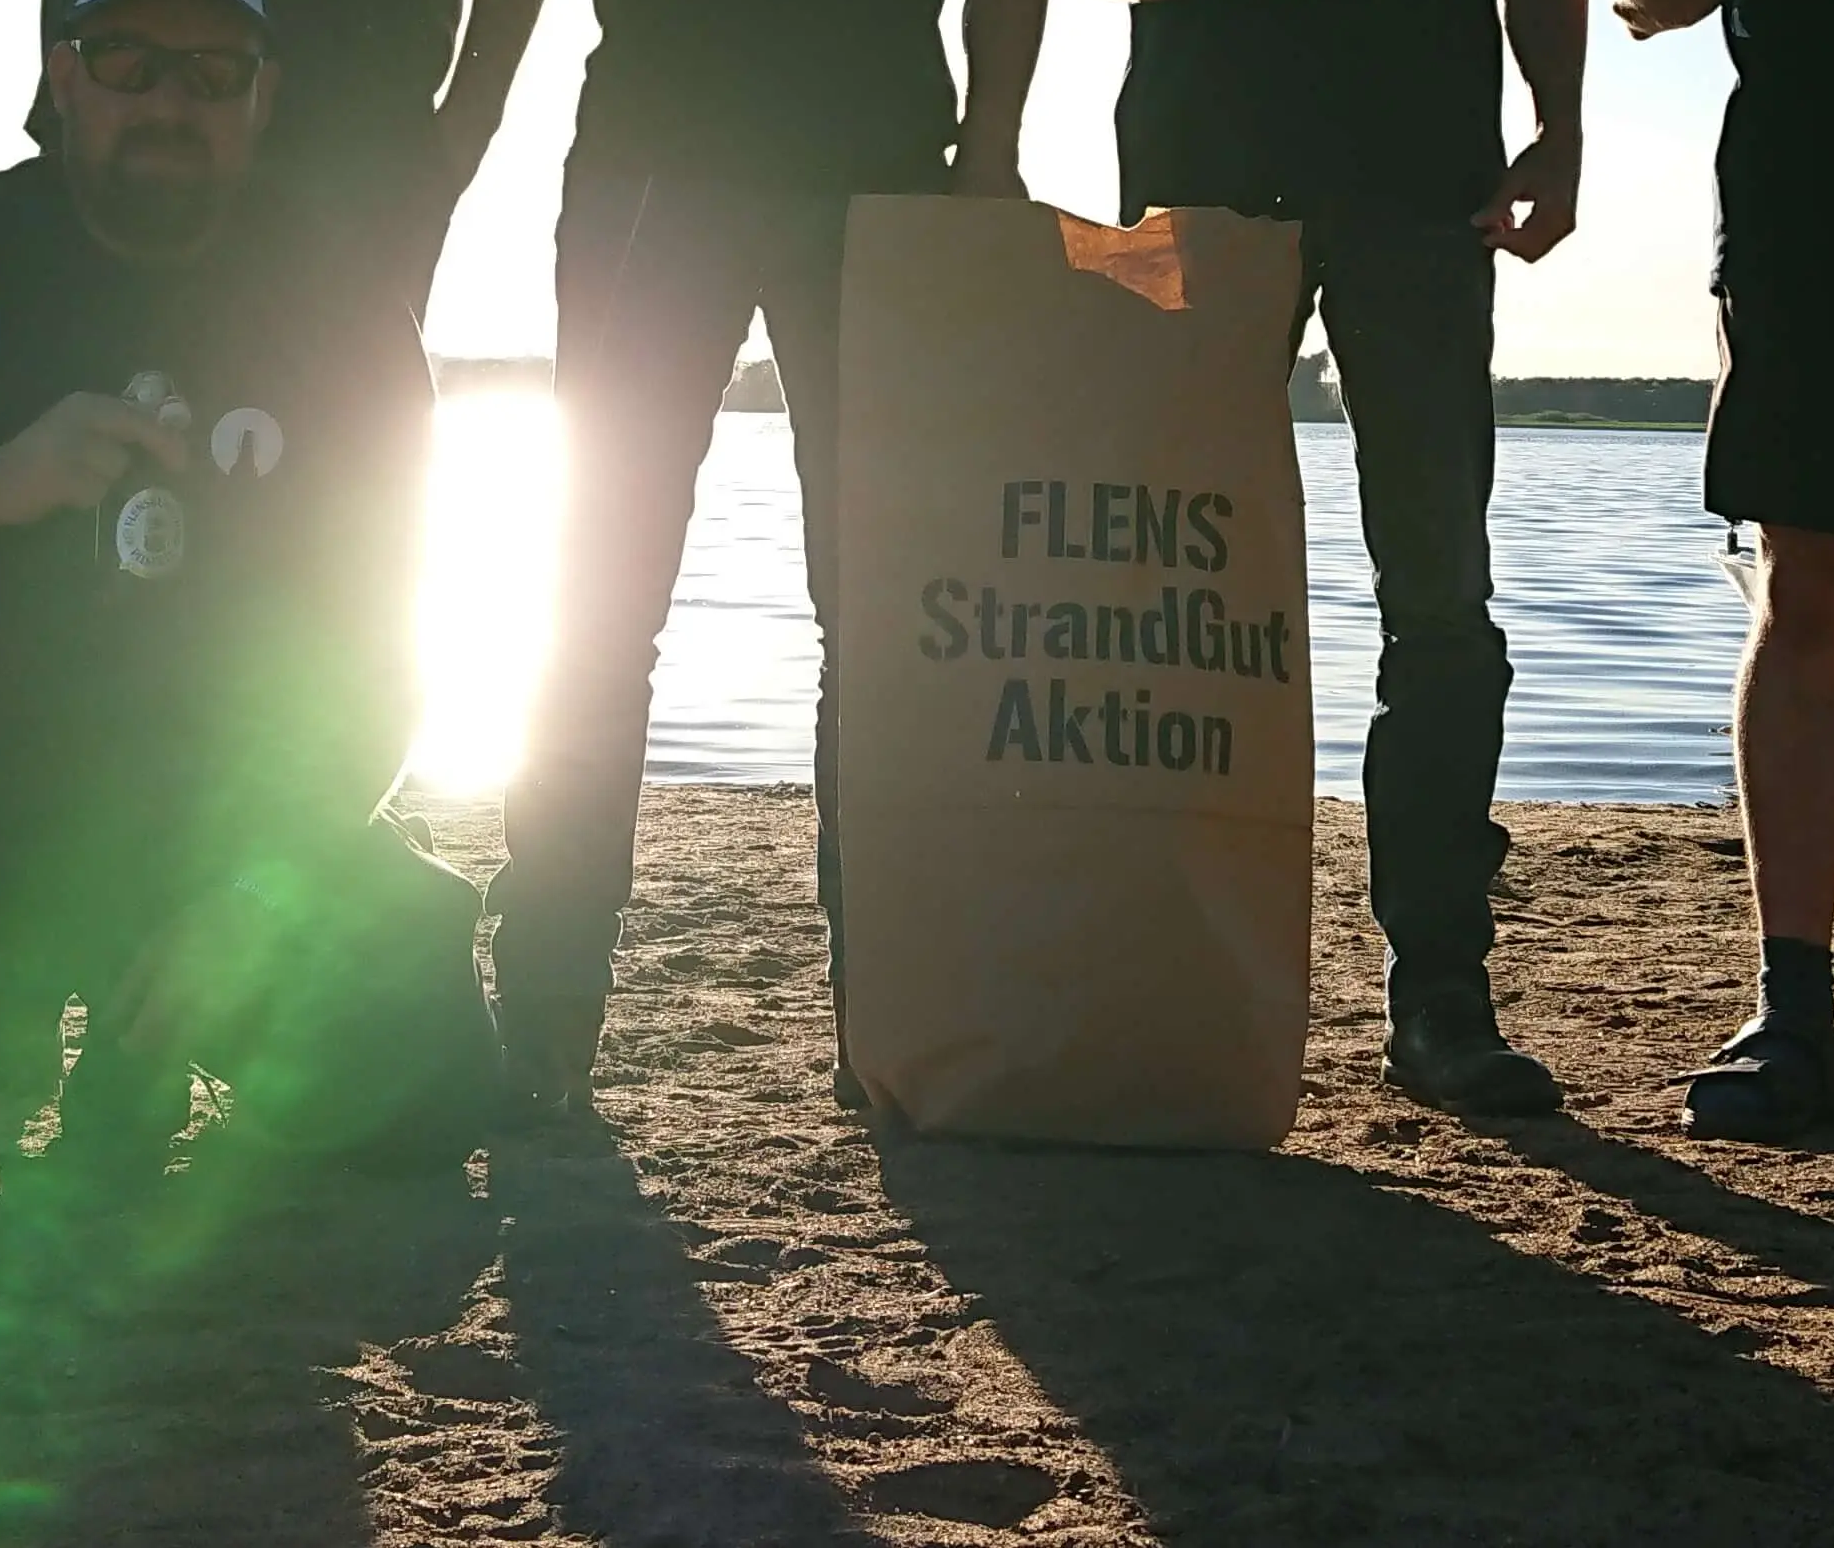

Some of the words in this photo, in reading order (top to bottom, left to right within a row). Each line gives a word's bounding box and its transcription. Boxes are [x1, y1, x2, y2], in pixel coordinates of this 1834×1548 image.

[1000, 480, 1234, 573] FLENS
[917, 577, 1291, 684] StrandGut
[985, 678, 1233, 776] Aktion
